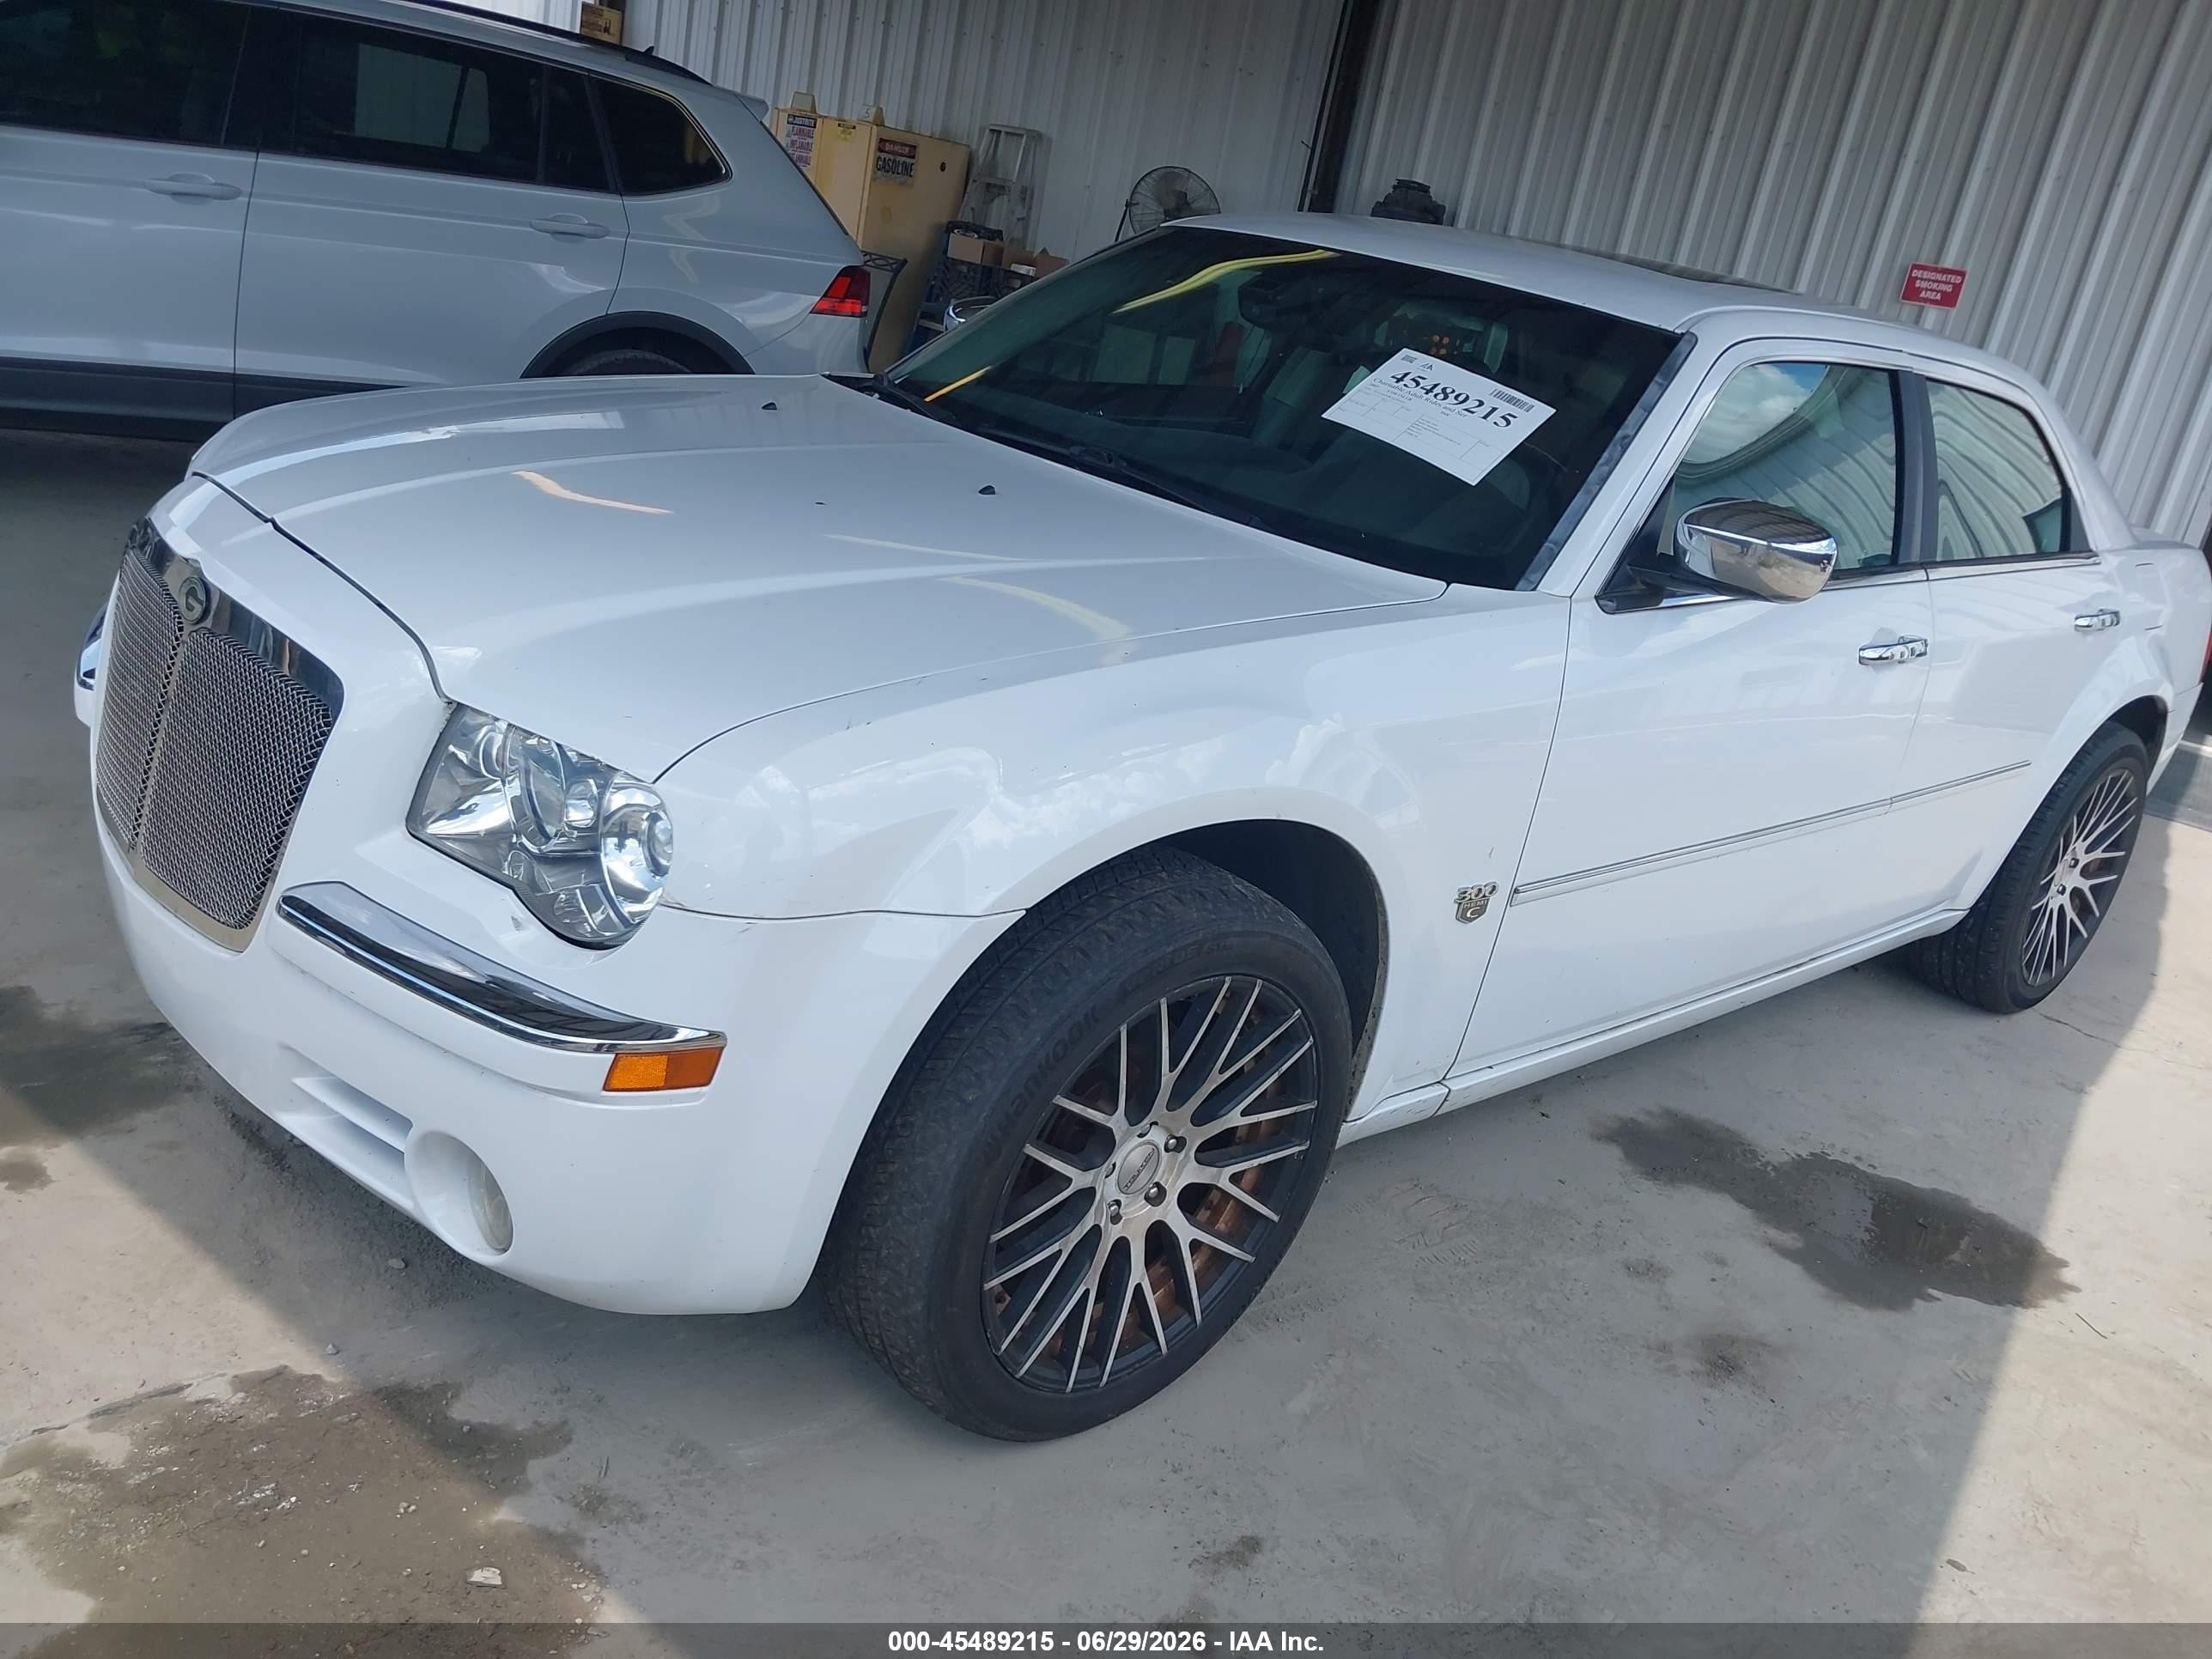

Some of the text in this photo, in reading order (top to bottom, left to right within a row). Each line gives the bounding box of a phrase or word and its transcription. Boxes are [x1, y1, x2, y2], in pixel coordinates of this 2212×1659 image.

[876, 155, 915, 178] GASOLINE
[1911, 269, 1962, 283] DESIGNATED
[1915, 280, 1953, 292] SMOKING
[1919, 290, 1942, 301] AREA
[1374, 378, 1406, 392] Charitable
[1407, 390, 1424, 400] Adult
[1425, 397, 1442, 407] Rides
[1390, 371, 1518, 428] 45489215
[1454, 881, 1499, 903] 300
[1466, 906, 1481, 918] C
